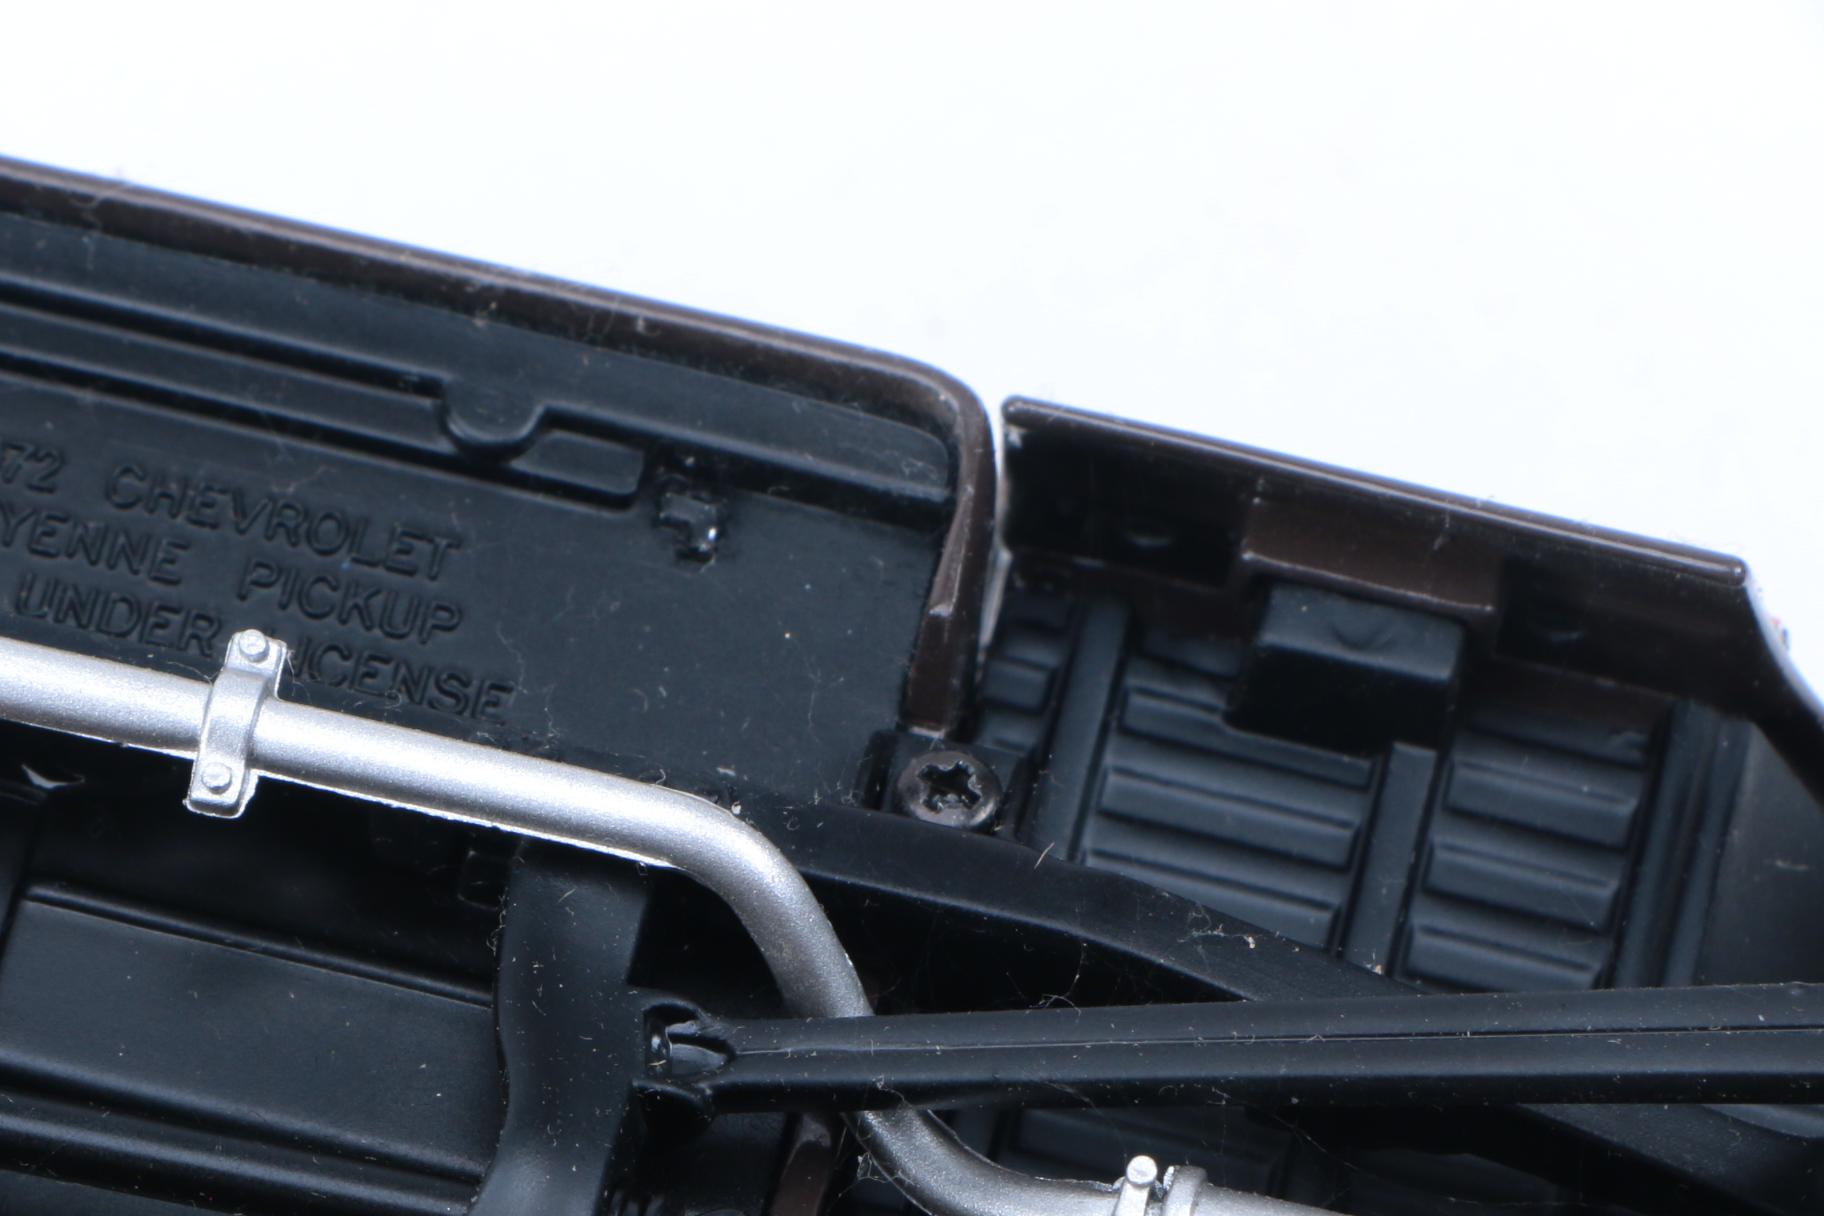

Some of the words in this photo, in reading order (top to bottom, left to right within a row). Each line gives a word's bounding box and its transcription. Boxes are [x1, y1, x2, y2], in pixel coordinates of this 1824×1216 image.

[102, 464, 462, 580] CHEVROLET
[15, 577, 223, 658] UNDER
[268, 630, 514, 726] ICENSE
[237, 558, 464, 646] PICKUP
